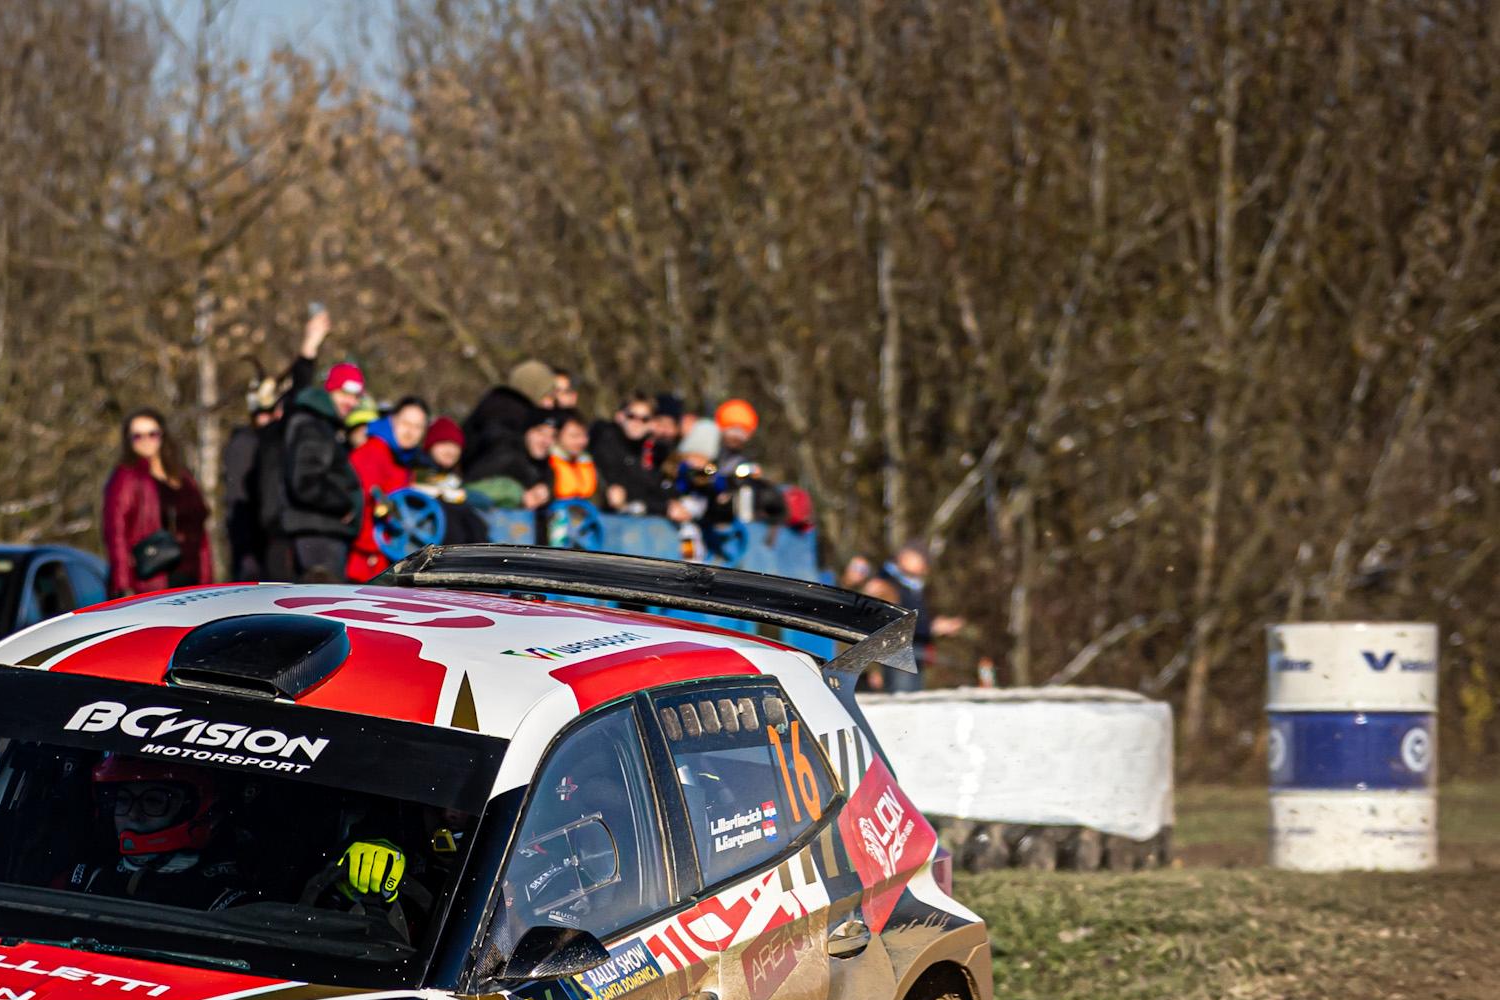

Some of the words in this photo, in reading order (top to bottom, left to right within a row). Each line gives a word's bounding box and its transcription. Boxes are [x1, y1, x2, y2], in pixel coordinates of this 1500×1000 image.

[63, 701, 330, 762] BCVISION
[140, 744, 311, 773] MOTORSPORT
[767, 720, 822, 822] 16
[587, 960, 620, 988] RALLY
[616, 944, 649, 975] SHOW
[599, 978, 625, 1000] SANTA
[622, 965, 660, 994] DOMENICA
